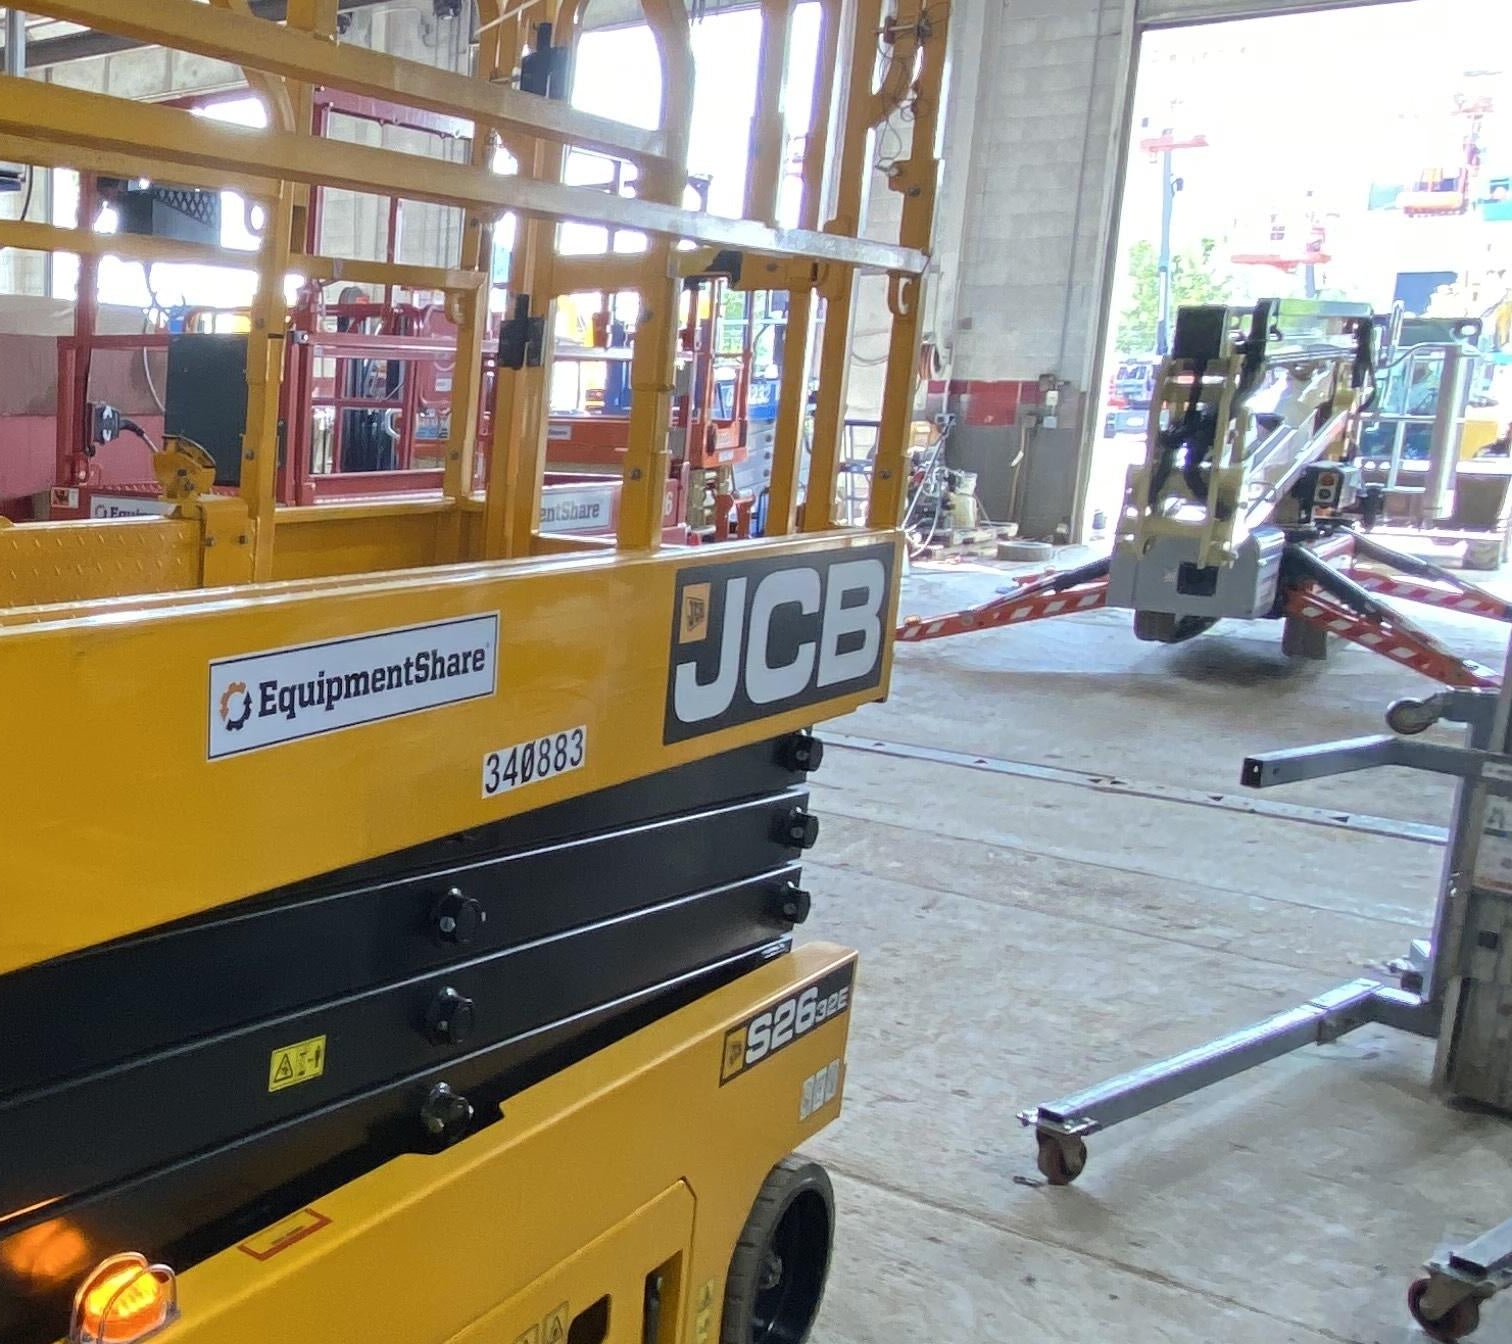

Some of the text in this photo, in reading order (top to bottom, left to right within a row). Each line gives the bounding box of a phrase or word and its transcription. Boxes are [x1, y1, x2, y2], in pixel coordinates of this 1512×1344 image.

[674, 559, 885, 723] JCB
[258, 647, 486, 719] EquipmentShare
[484, 728, 583, 793] 340883
